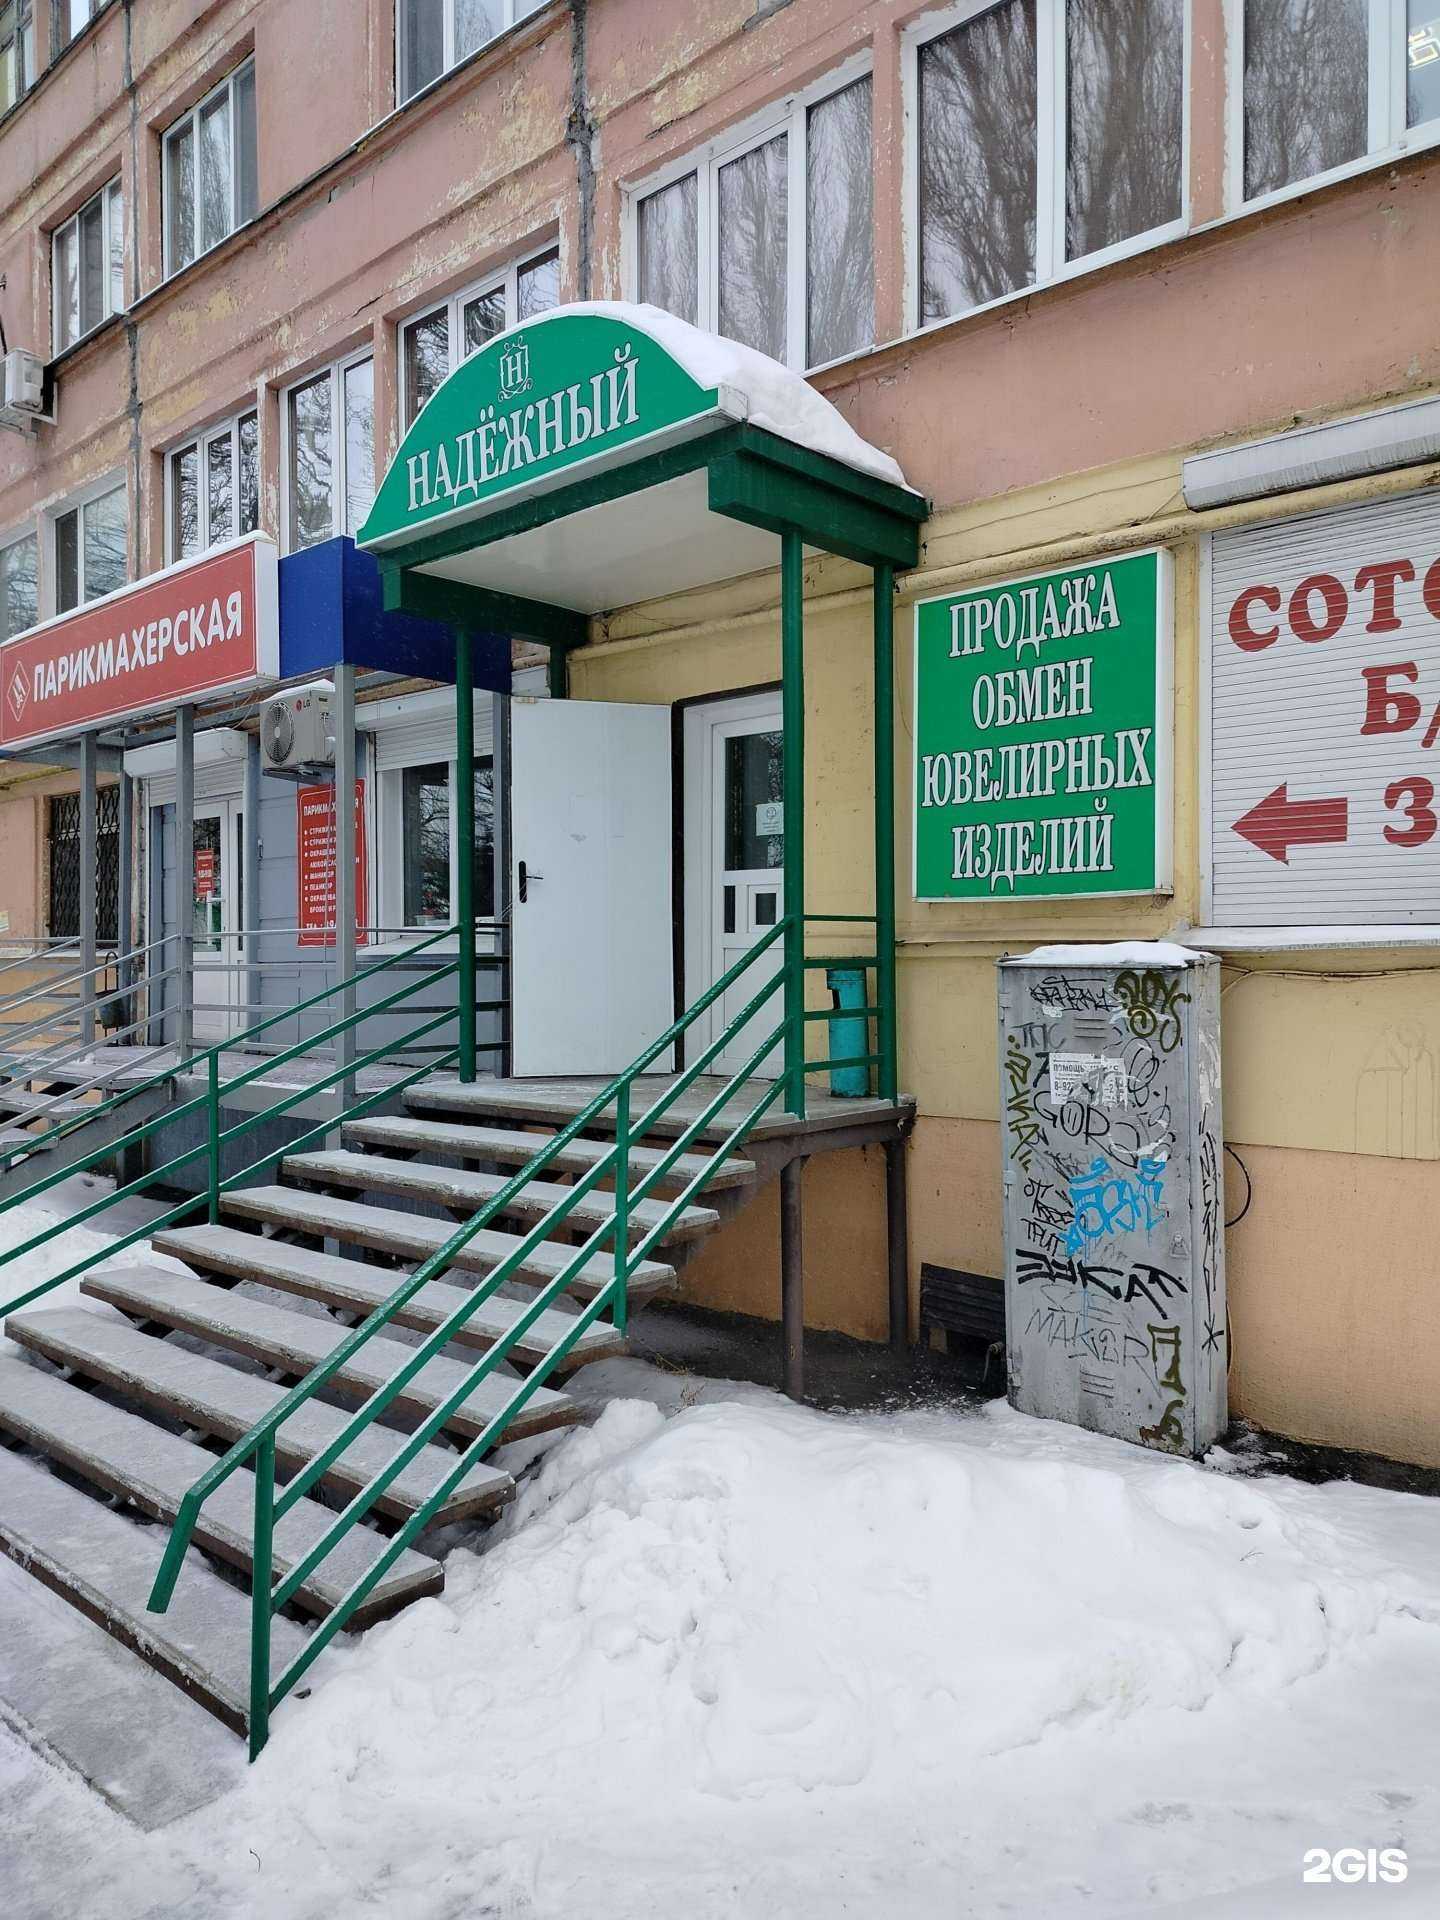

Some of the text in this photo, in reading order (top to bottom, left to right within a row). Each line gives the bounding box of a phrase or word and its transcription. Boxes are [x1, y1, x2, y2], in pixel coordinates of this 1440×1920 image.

[407, 342, 640, 513] НАДЁЖНЫЙ
[33, 590, 242, 703] ПАРИКМАХЕРСКАЯ
[949, 572, 1121, 661] ПРОДАЖА
[973, 657, 1093, 730] ОБМЕН
[921, 727, 1153, 808] ЮВЕЛИРНЫХ
[951, 798, 1115, 892] ИЗДЕЛИЙ
